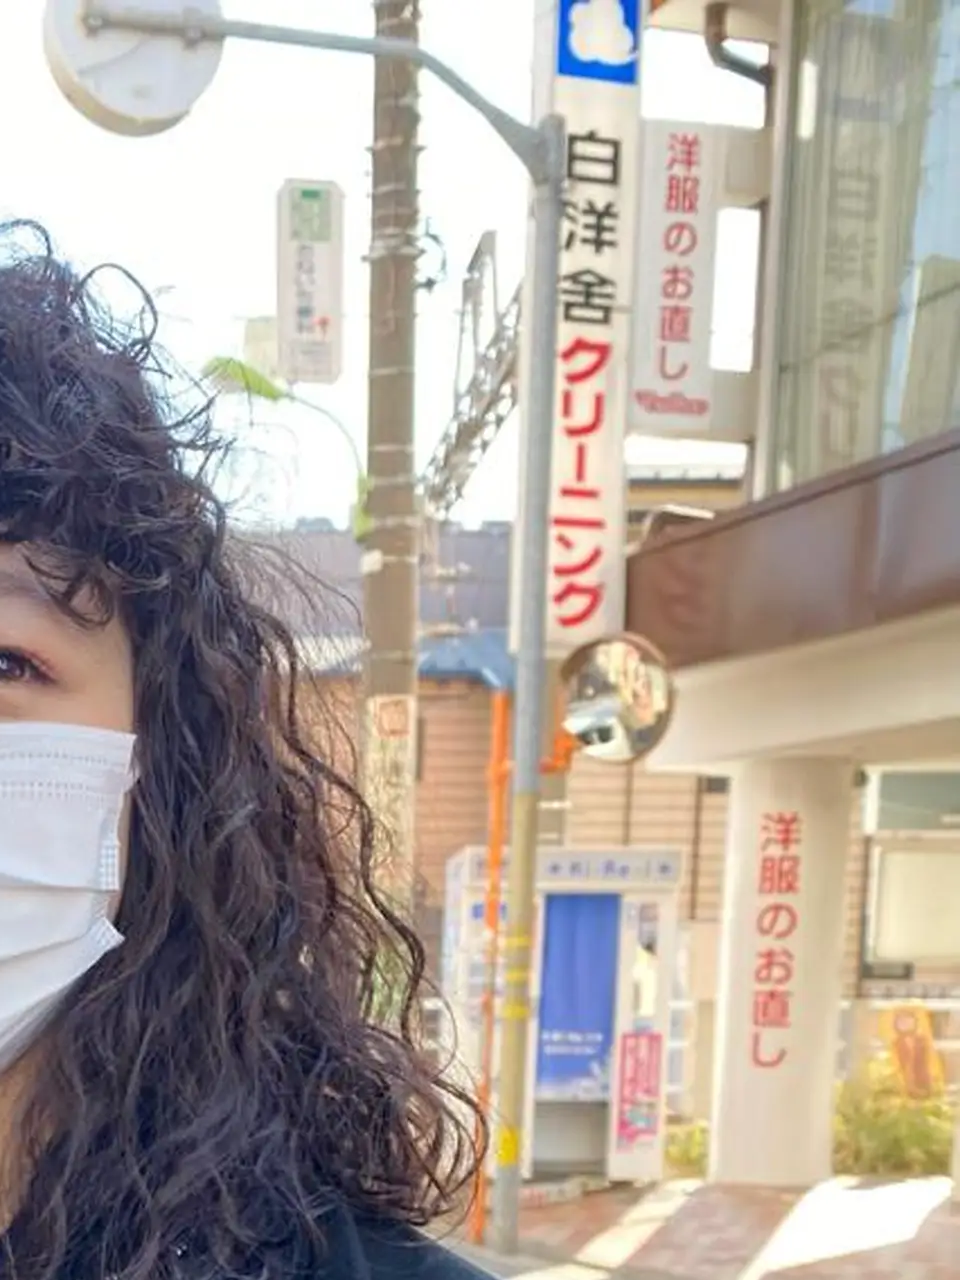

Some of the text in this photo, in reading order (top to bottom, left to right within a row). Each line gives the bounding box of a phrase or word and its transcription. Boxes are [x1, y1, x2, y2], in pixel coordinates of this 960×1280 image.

[658, 132, 700, 381] 洋服のお直し
[751, 811, 801, 1068] 洋服のお直し
